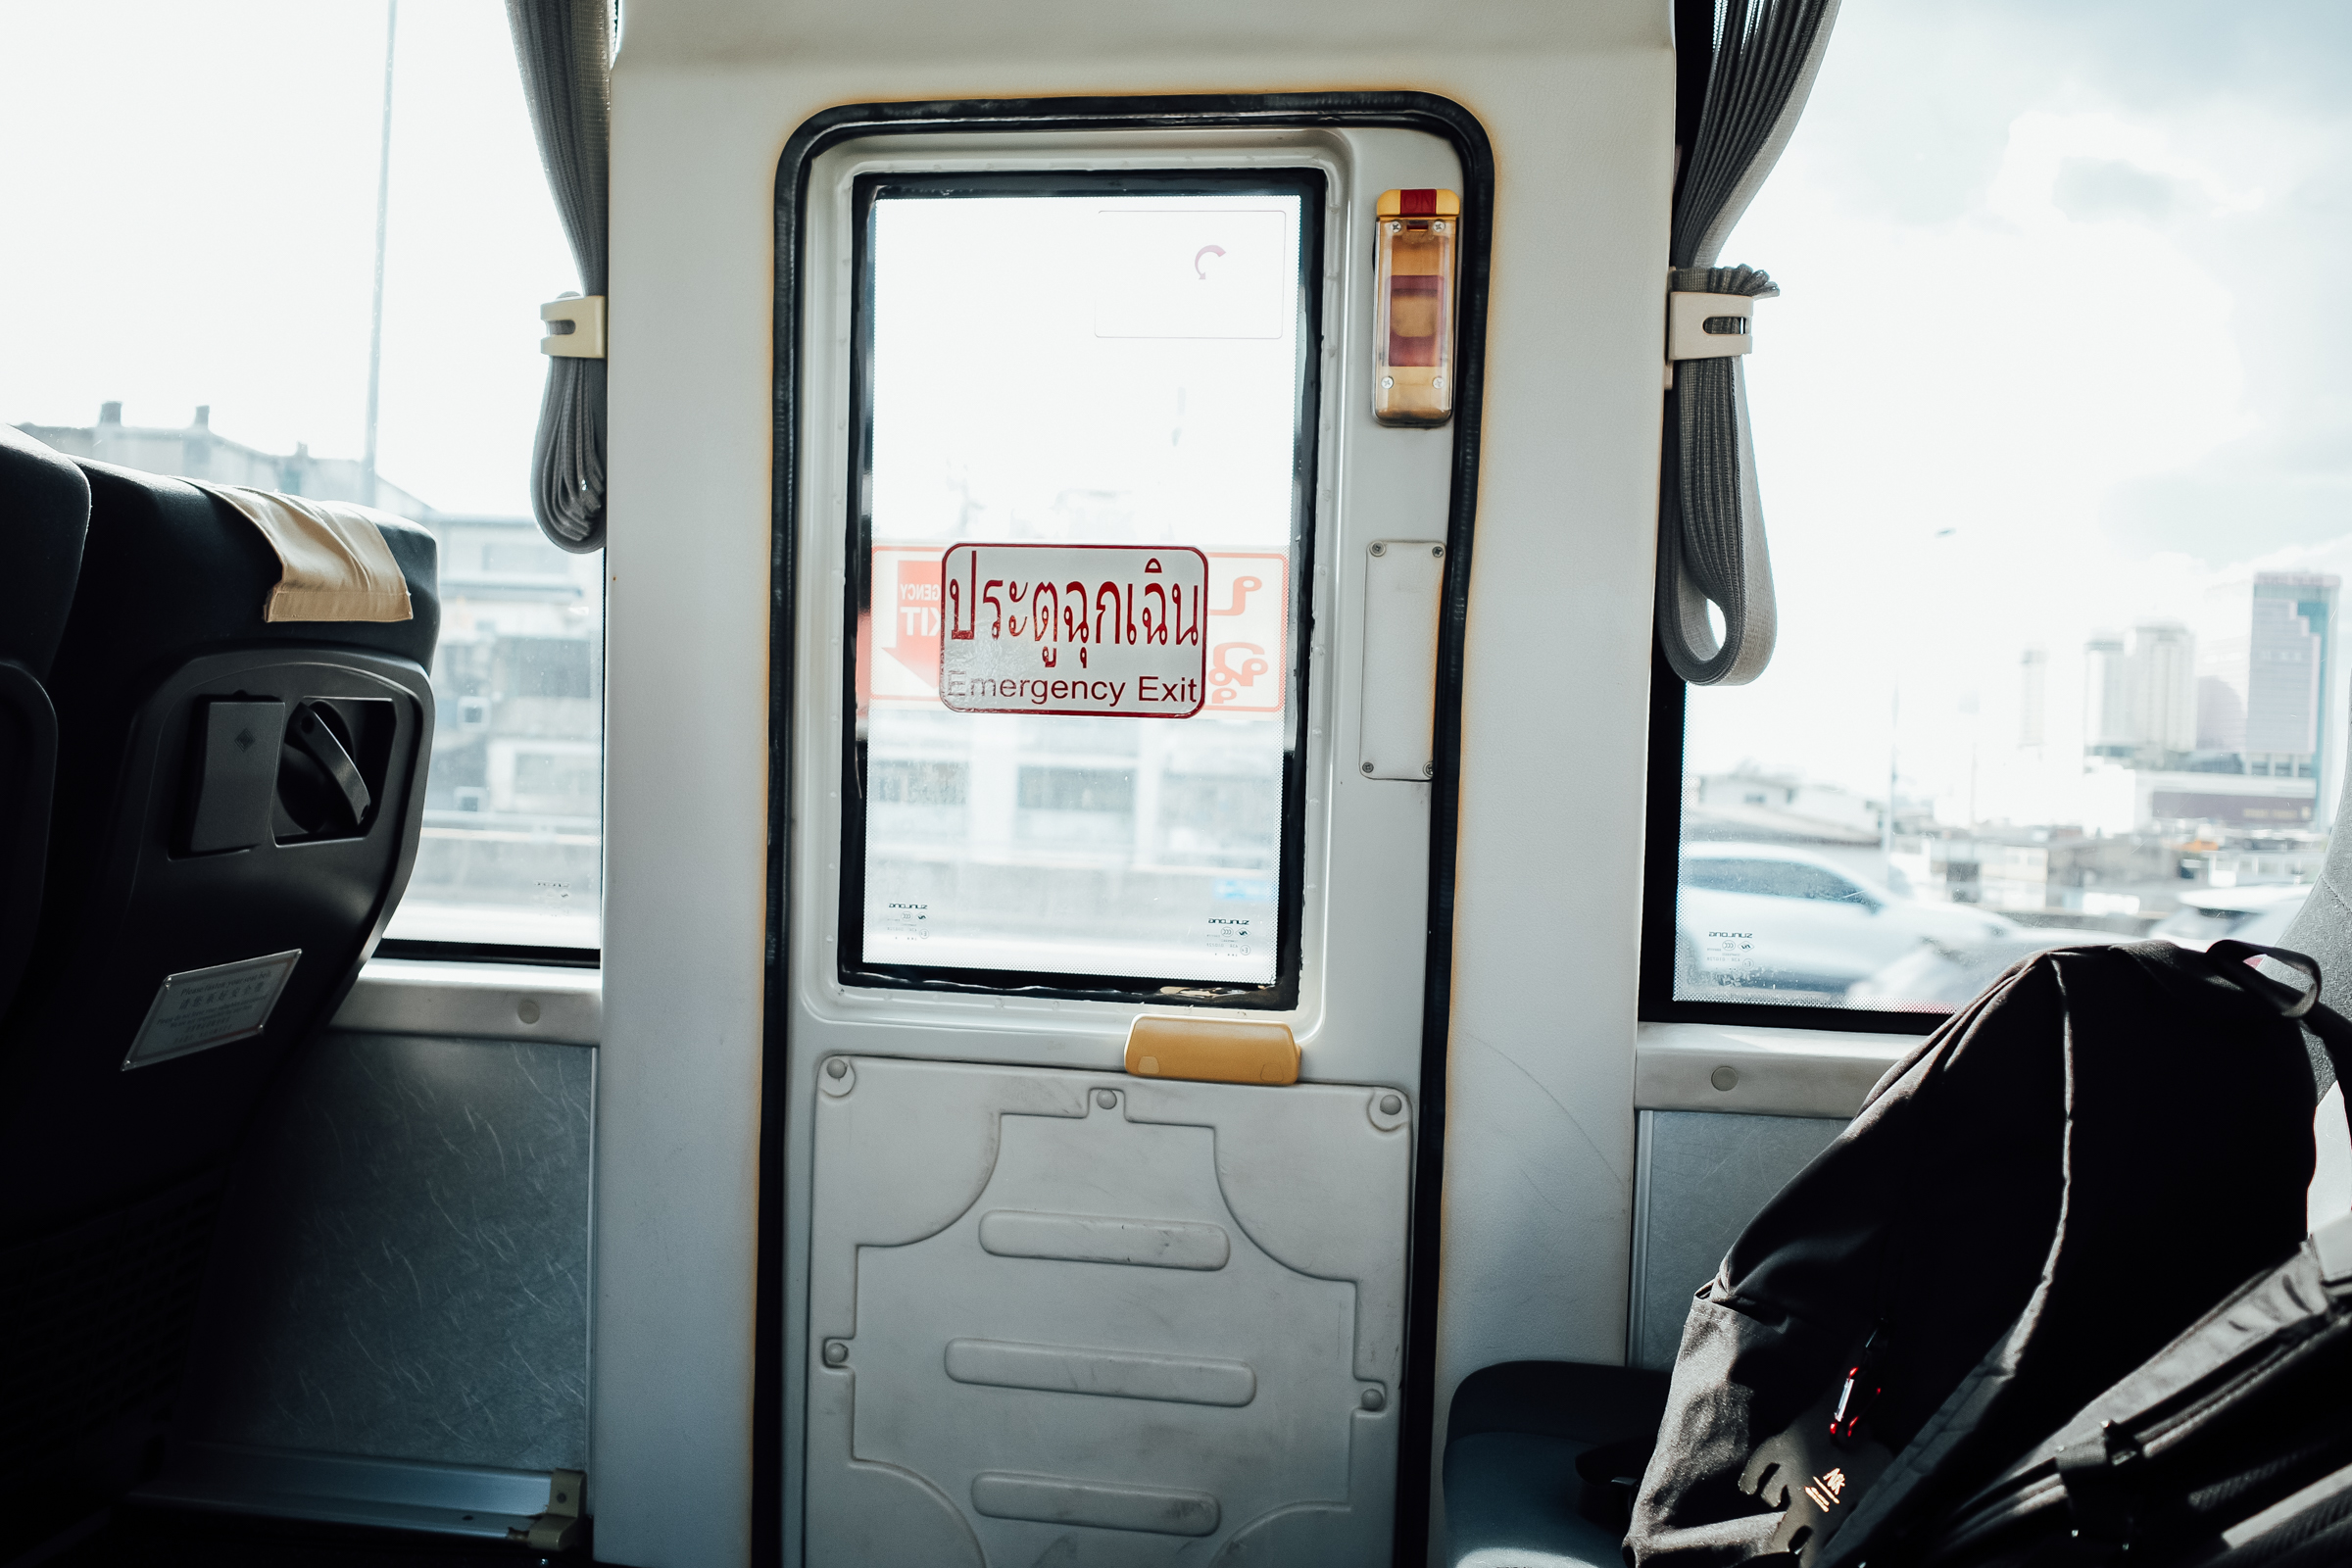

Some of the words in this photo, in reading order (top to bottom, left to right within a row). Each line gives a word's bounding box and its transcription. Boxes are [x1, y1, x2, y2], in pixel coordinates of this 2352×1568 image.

[949, 550, 1199, 668] ประตูฉุกเฉิน
[947, 670, 1127, 707] Emergency
[1138, 675, 1198, 703] Exit
